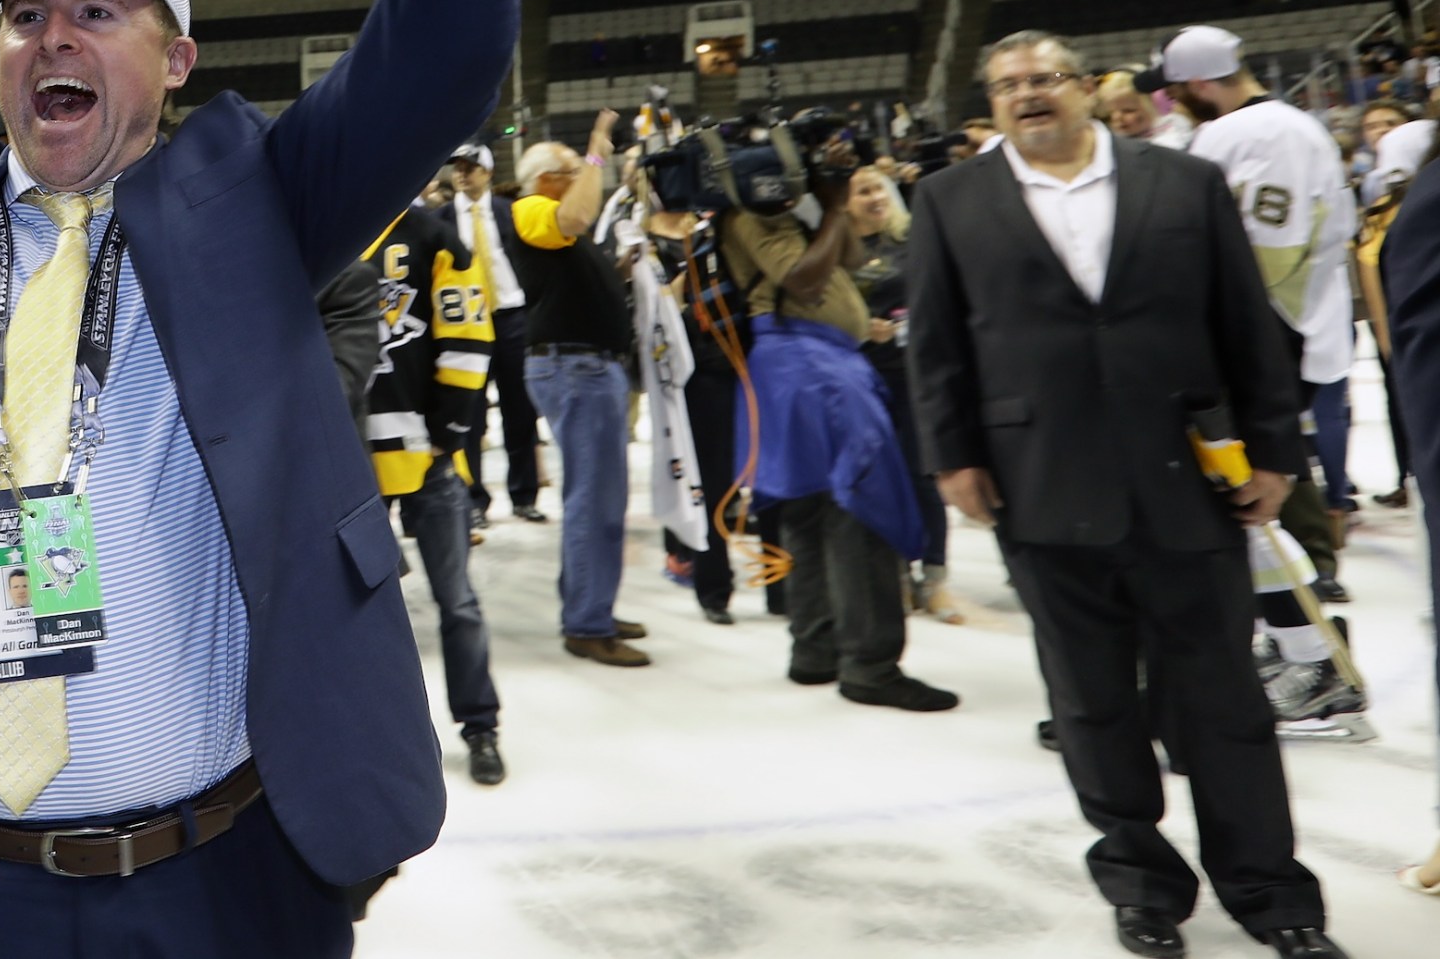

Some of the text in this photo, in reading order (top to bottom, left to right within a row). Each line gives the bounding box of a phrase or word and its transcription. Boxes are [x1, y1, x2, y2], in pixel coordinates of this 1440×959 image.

[384, 243, 410, 281] C
[94, 272, 111, 341] STANLEY
[438, 287, 486, 324] 87
[40, 630, 102, 645] MacKinnon
[58, 619, 82, 630] Dan
[1, 642, 16, 653] All
